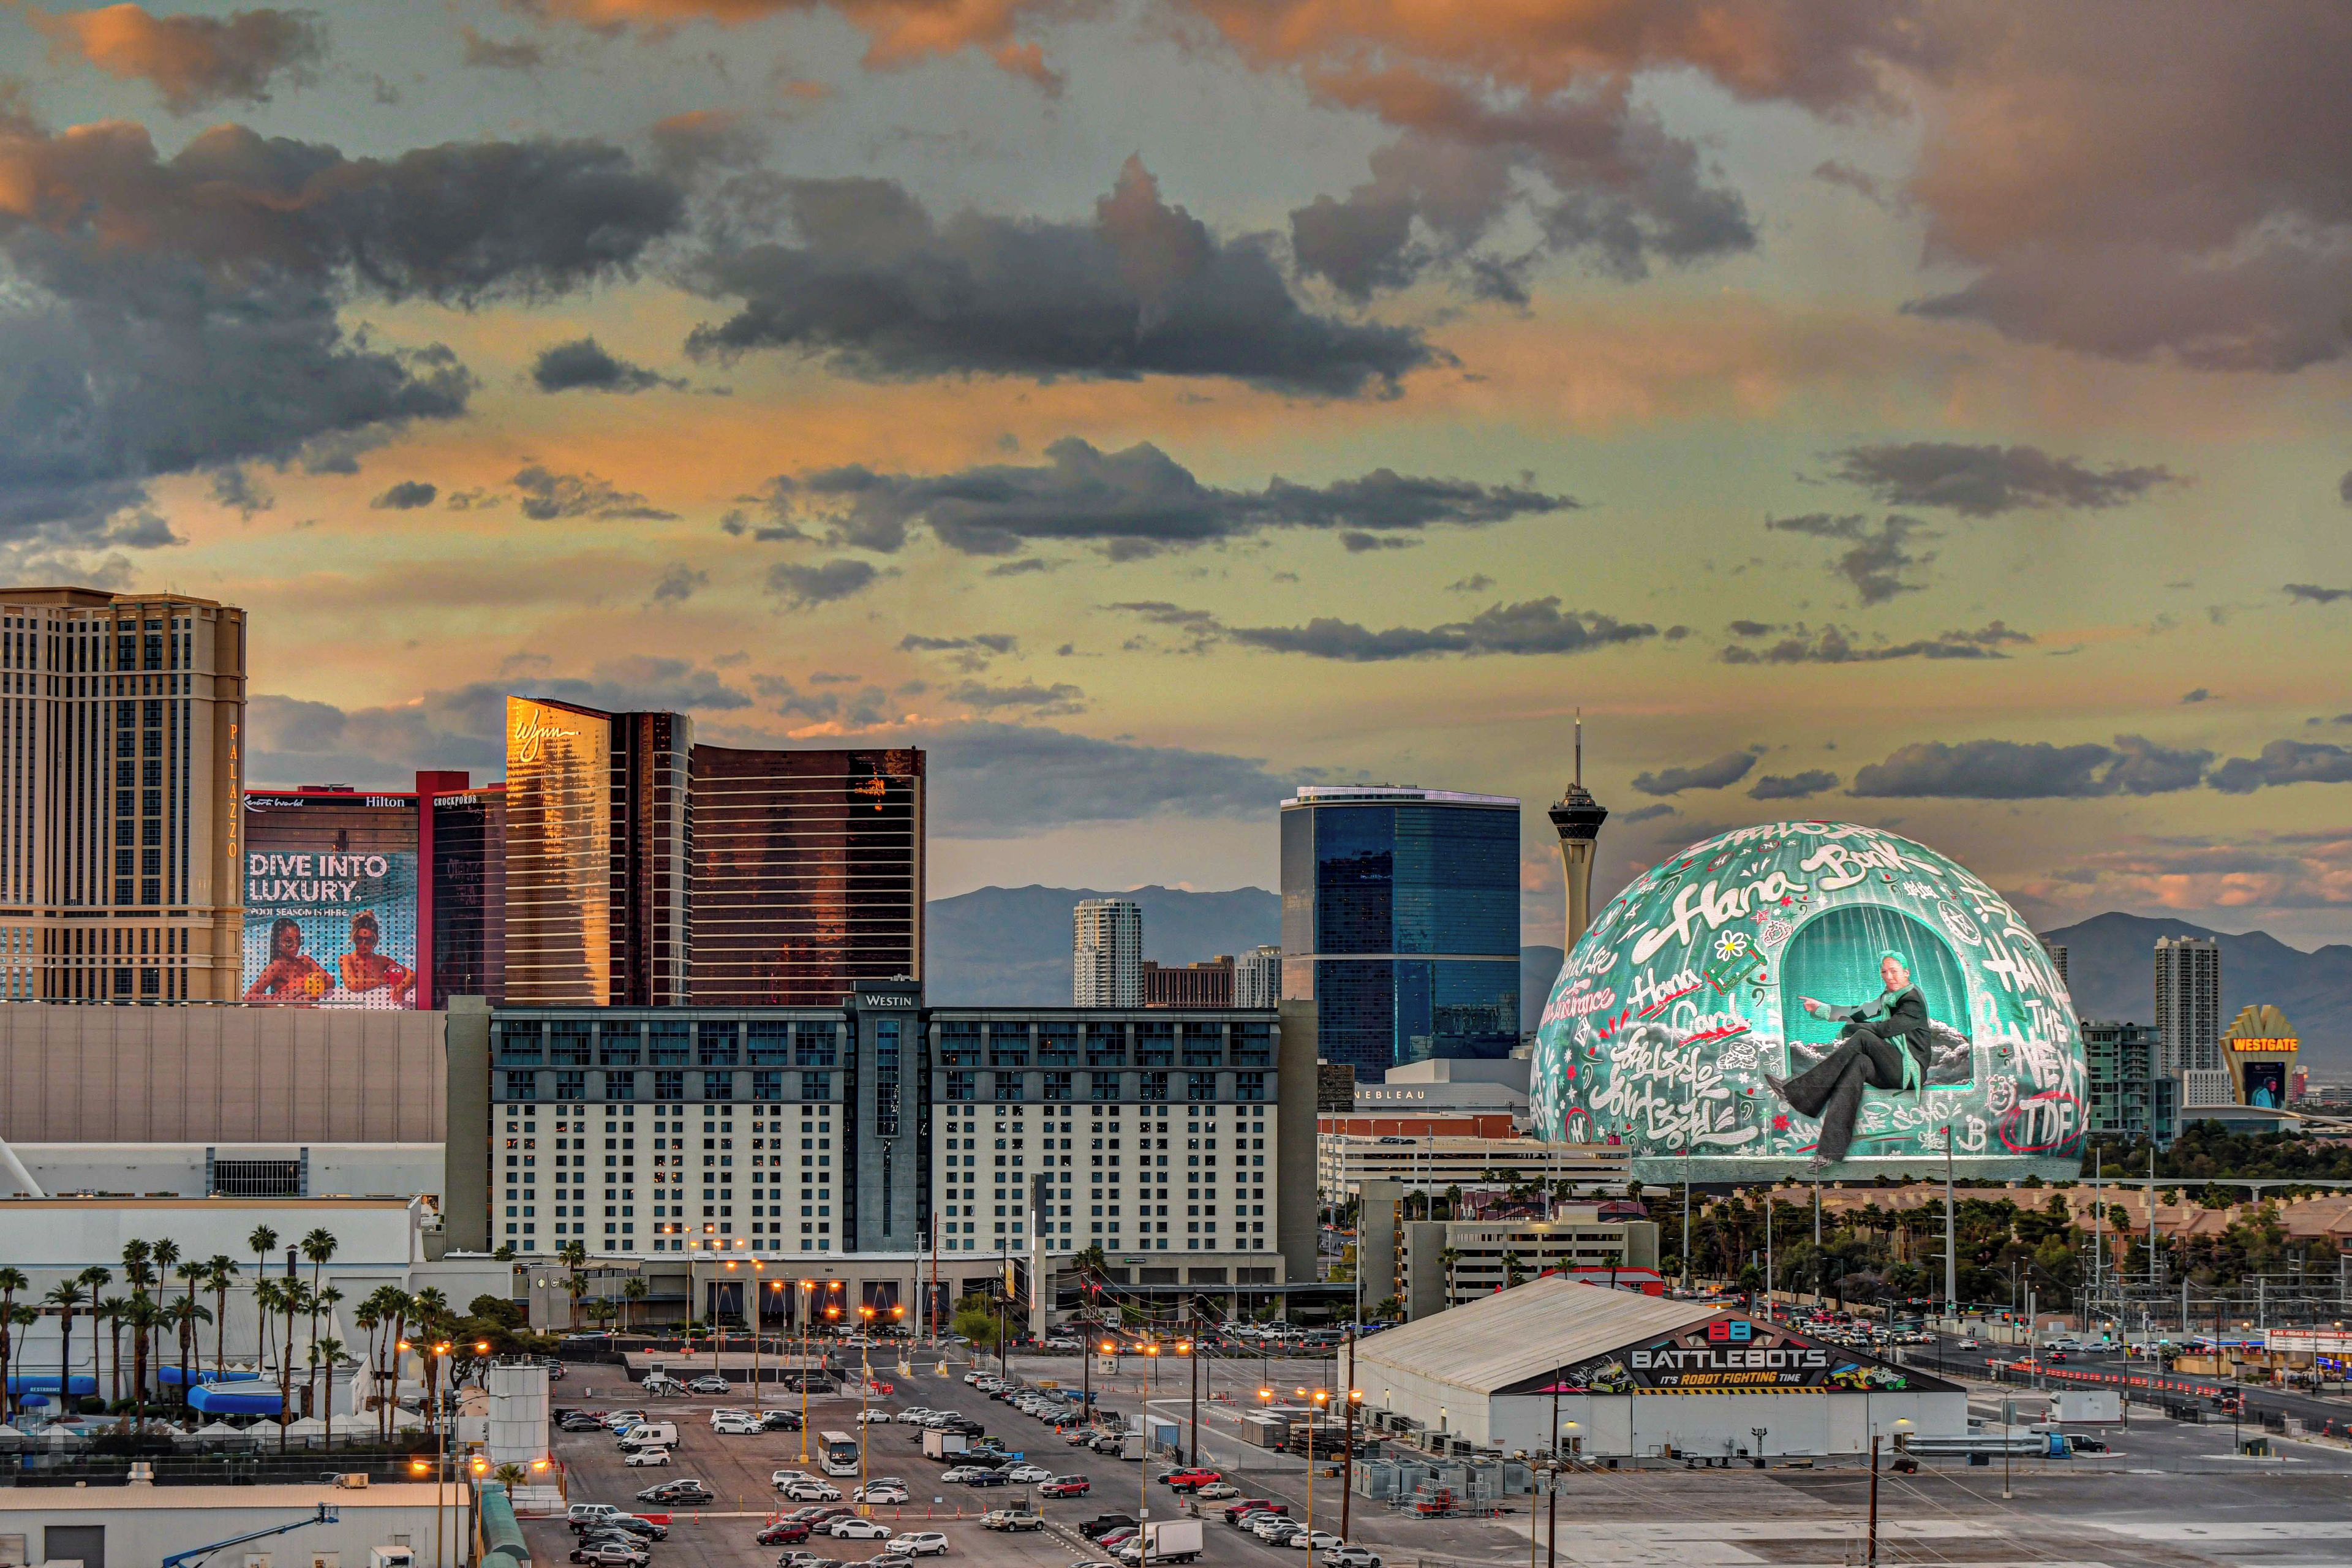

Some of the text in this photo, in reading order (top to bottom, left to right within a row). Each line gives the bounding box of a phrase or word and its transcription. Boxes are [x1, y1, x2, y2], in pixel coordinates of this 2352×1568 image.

[228, 724, 238, 858] PALAZZO
[366, 796, 405, 807] Hilton
[434, 795, 477, 807] CROCKFORDS
[274, 798, 304, 807] World
[250, 854, 387, 877] DIVE INTO
[250, 880, 361, 902] LUXURY.
[1631, 870, 1807, 964] Hana
[1800, 840, 1945, 891] Bank
[1627, 968, 1702, 1009] Hana
[1672, 993, 1751, 1040] Card
[2233, 1038, 2298, 1051] WESTGATE
[2019, 1098, 2073, 1150] TDF
[1632, 1349, 1827, 1370] BATTLEBOTS
[1660, 1371, 1801, 1385] IT'S ROBOT FIGHTING TIME
